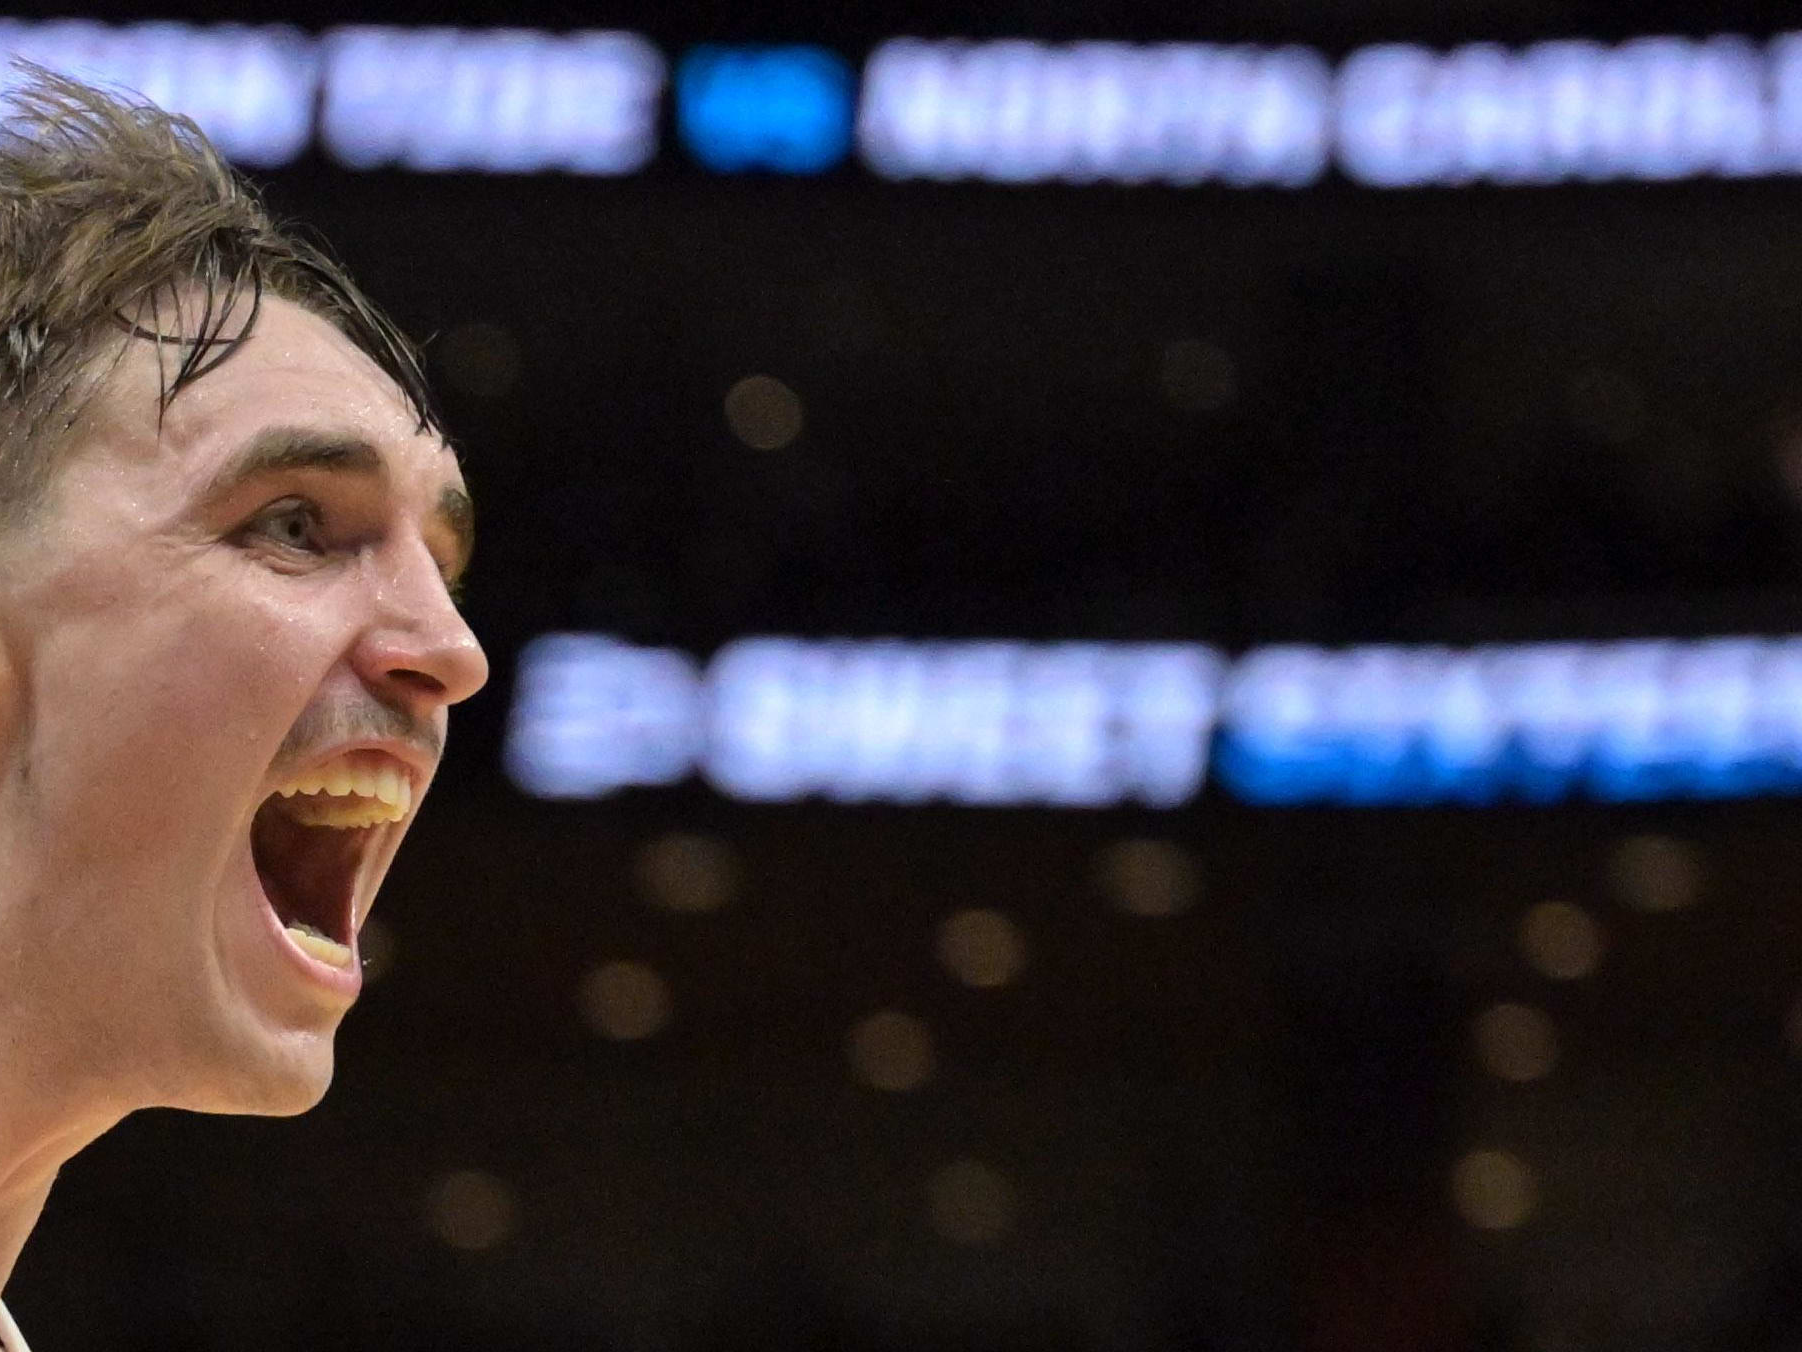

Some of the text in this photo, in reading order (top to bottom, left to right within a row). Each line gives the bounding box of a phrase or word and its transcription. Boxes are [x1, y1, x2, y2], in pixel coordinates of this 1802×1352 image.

[321, 26, 656, 172] TIDE
[861, 42, 1324, 182] NORTH
[699, 638, 1218, 804] SWEET
